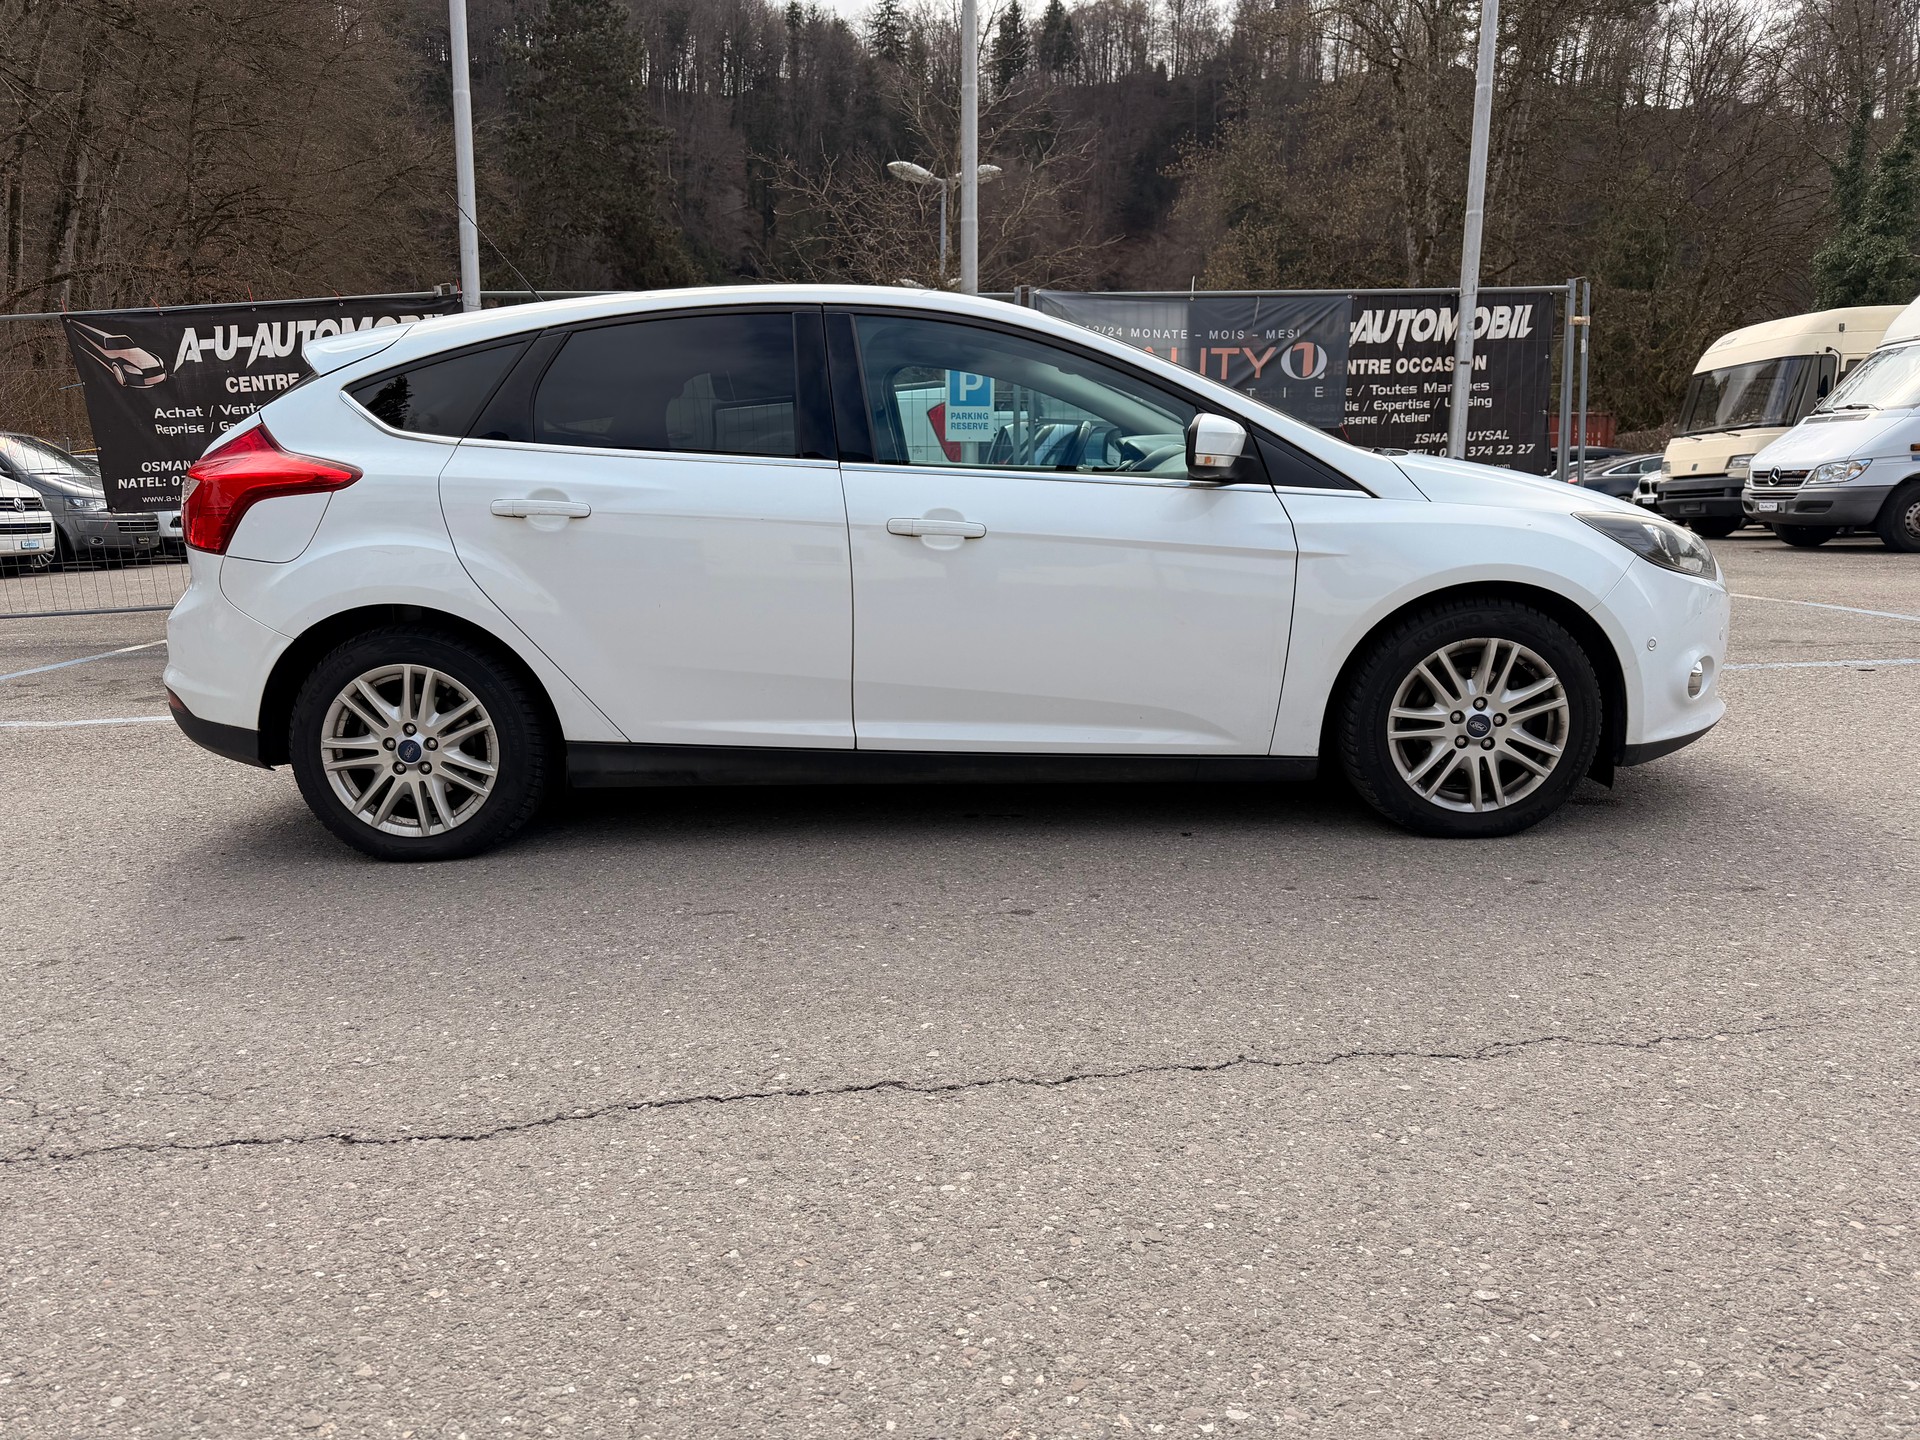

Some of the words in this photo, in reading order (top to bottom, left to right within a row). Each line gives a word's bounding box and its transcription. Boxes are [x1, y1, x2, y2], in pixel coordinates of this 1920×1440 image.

[1130, 328, 1187, 339] MONATE
[1209, 330, 1245, 340] MOIS
[1266, 329, 1300, 339] MESI
[1369, 384, 1417, 396] Toutes
[154, 405, 204, 419] Achat
[1373, 401, 1431, 413] Expertise
[951, 412, 989, 420] PARKING
[1390, 412, 1431, 424] Atelier
[154, 423, 205, 437] Reprise
[951, 422, 989, 430] RESERVE
[1467, 430, 1510, 441] UYSAL
[1467, 445, 1494, 457] 374
[1496, 444, 1514, 455] 22
[1516, 443, 1536, 454] 27
[141, 460, 191, 473] OSMAN
[118, 477, 167, 489] NATEL:
